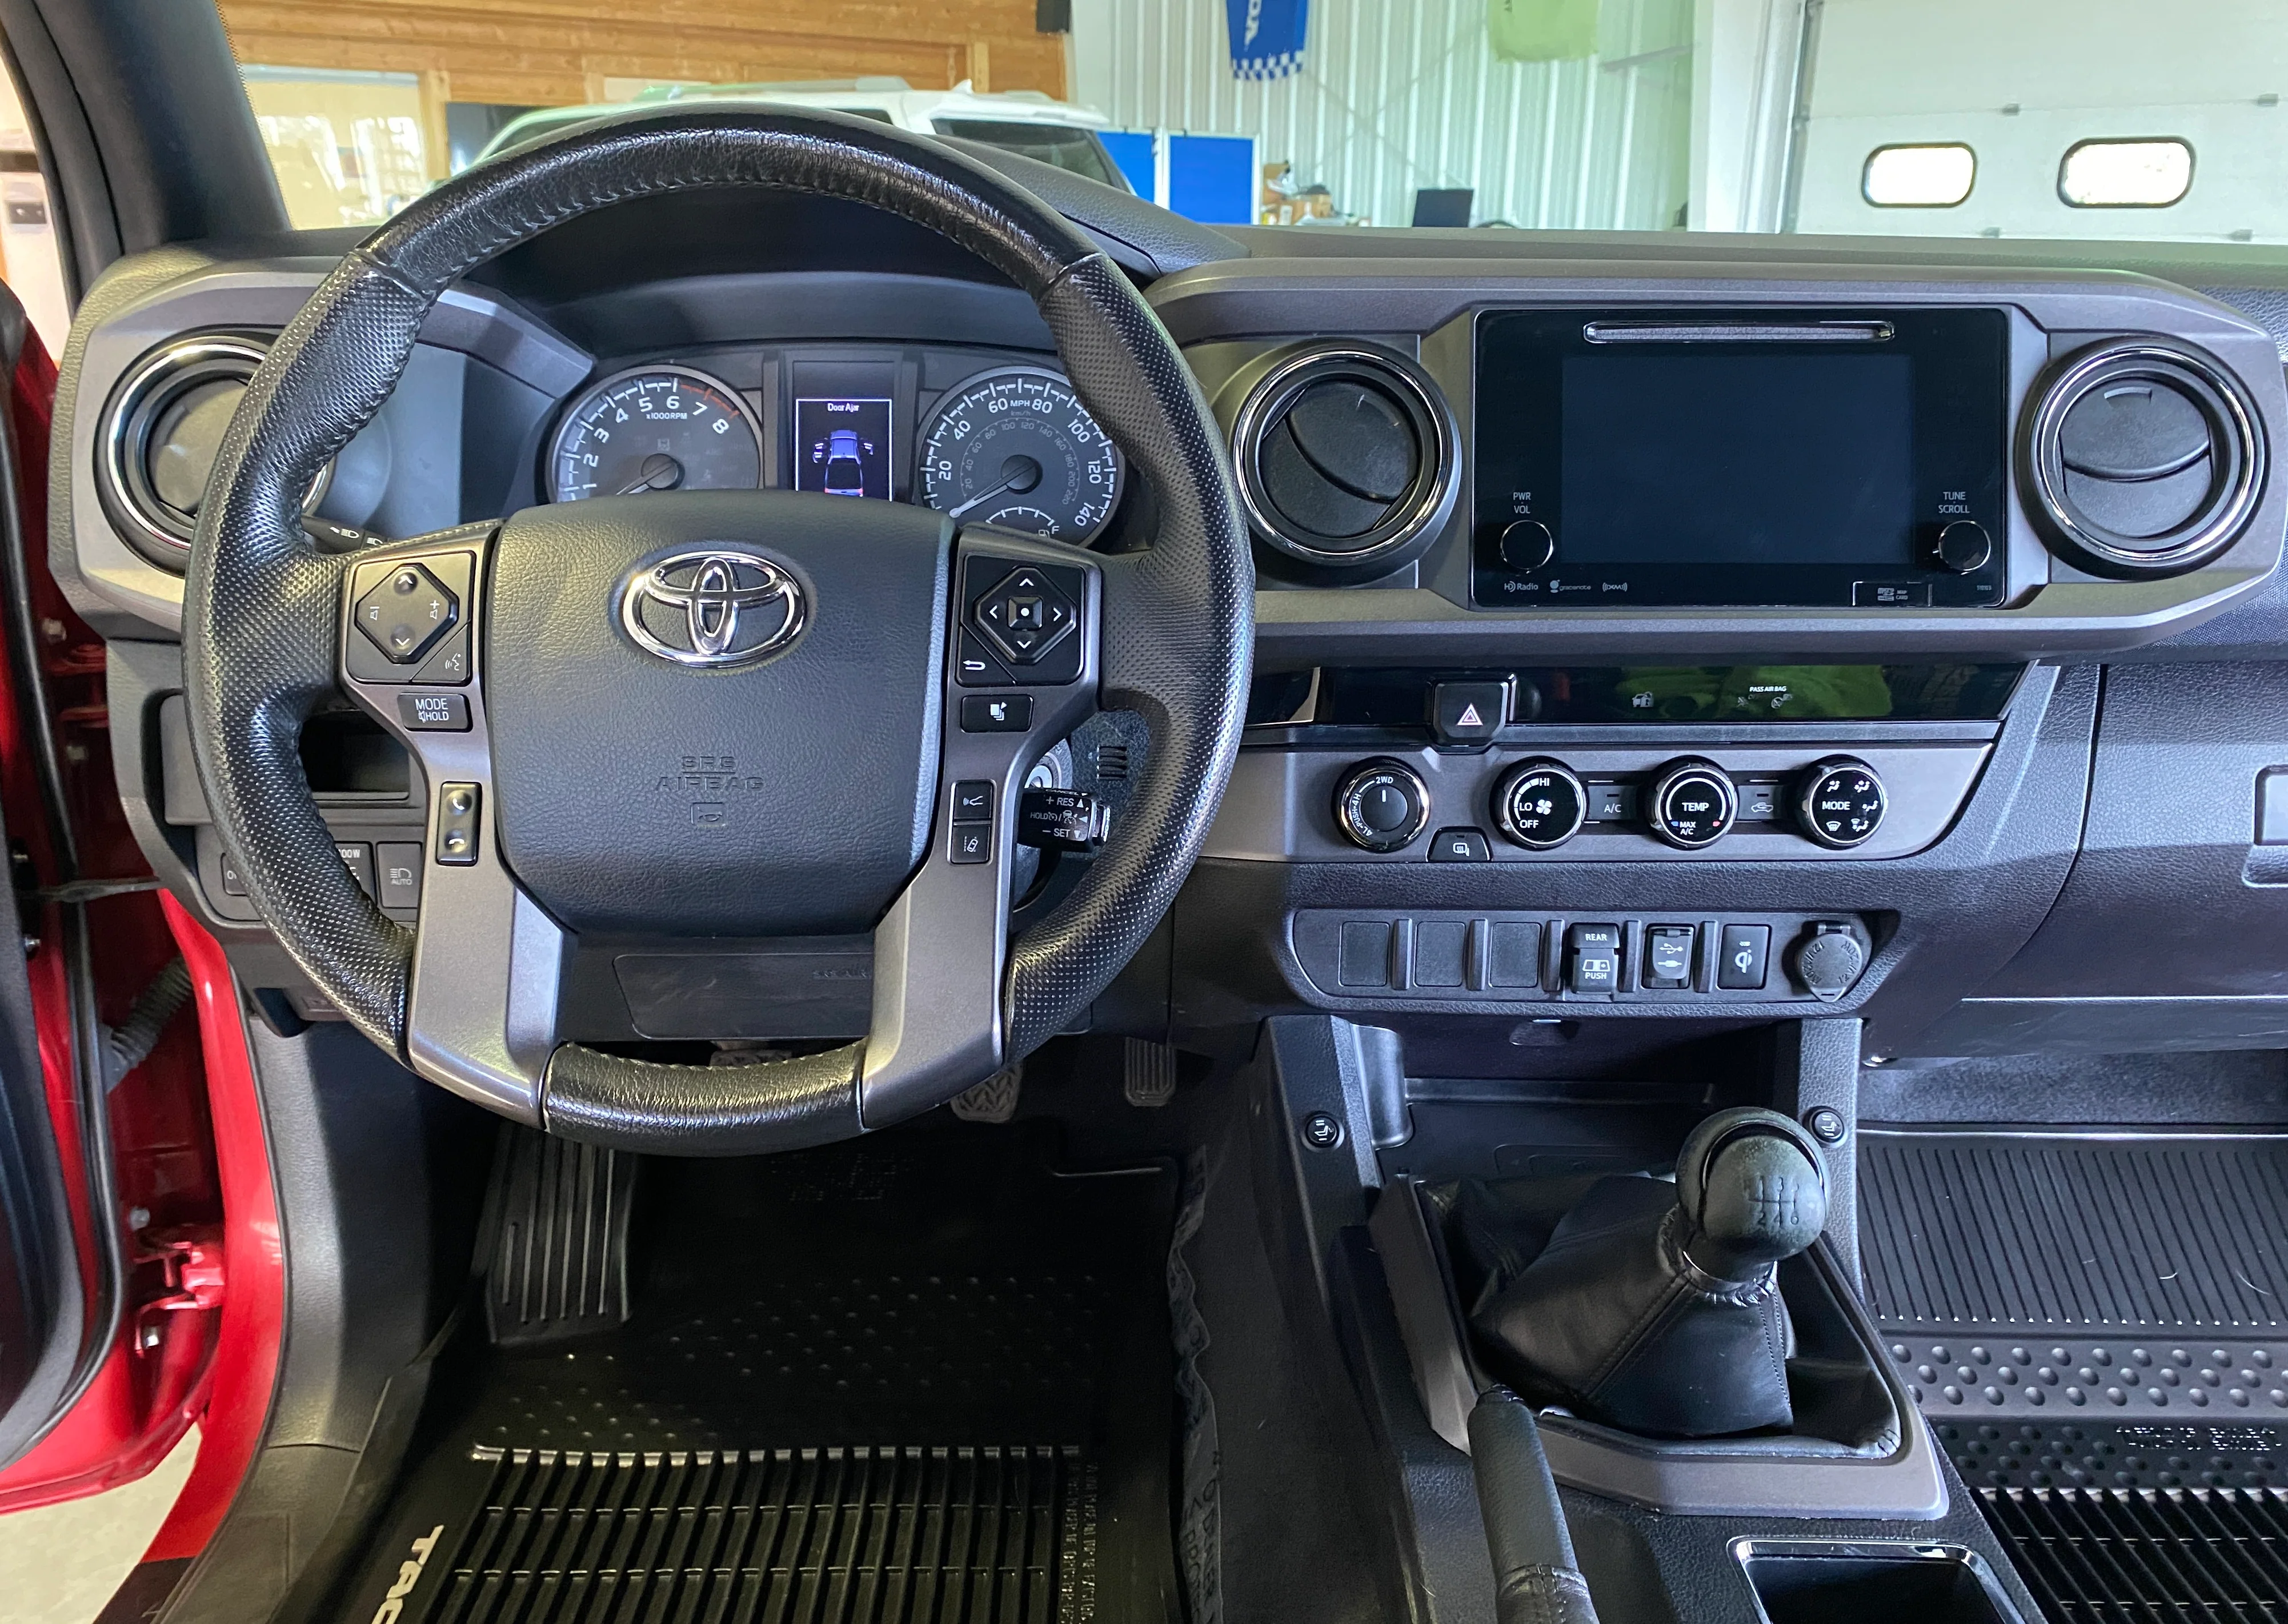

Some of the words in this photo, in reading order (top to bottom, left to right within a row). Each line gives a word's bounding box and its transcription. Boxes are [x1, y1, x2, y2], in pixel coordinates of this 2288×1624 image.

[638, 397, 653, 412] 5
[666, 396, 679, 410] 6
[692, 402, 707, 415] 7
[845, 403, 859, 412] Ajar
[988, 398, 1008, 414] 60
[1032, 399, 1053, 414] 80
[616, 408, 629, 423] 4
[712, 419, 729, 434] 8
[953, 420, 971, 440] 40
[1001, 422, 1015, 431] 100
[1021, 422, 1034, 430] 120
[1039, 426, 1052, 438] 140
[1067, 419, 1090, 443] 100
[594, 428, 609, 442] 3
[984, 429, 996, 439] 80
[972, 442, 982, 453] 60
[1055, 438, 1065, 451] 160
[583, 454, 599, 467] 2
[965, 459, 973, 471] 40
[1065, 454, 1074, 468] 180
[939, 460, 952, 480] 20
[1088, 460, 1102, 484] 120
[965, 478, 973, 489] 20
[1061, 490, 1072, 505] 220
[1074, 502, 1095, 527] 140
[1514, 506, 1530, 514] VOL
[1938, 505, 1970, 514] SCROLL
[1517, 582, 1538, 591] Radio
[415, 698, 448, 710] MODE
[426, 712, 449, 721] HOLD
[682, 756, 735, 769] SRS
[657, 777, 764, 791] AIRBAG
[1539, 778, 1550, 787] HI
[1057, 798, 1074, 807] RES
[1520, 803, 1533, 812] LO
[1604, 804, 1621, 813] A/C
[1682, 803, 1709, 812] TEMP
[1822, 801, 1850, 811] MODE
[1520, 820, 1538, 828] OFF
[1054, 828, 1070, 837] SET
